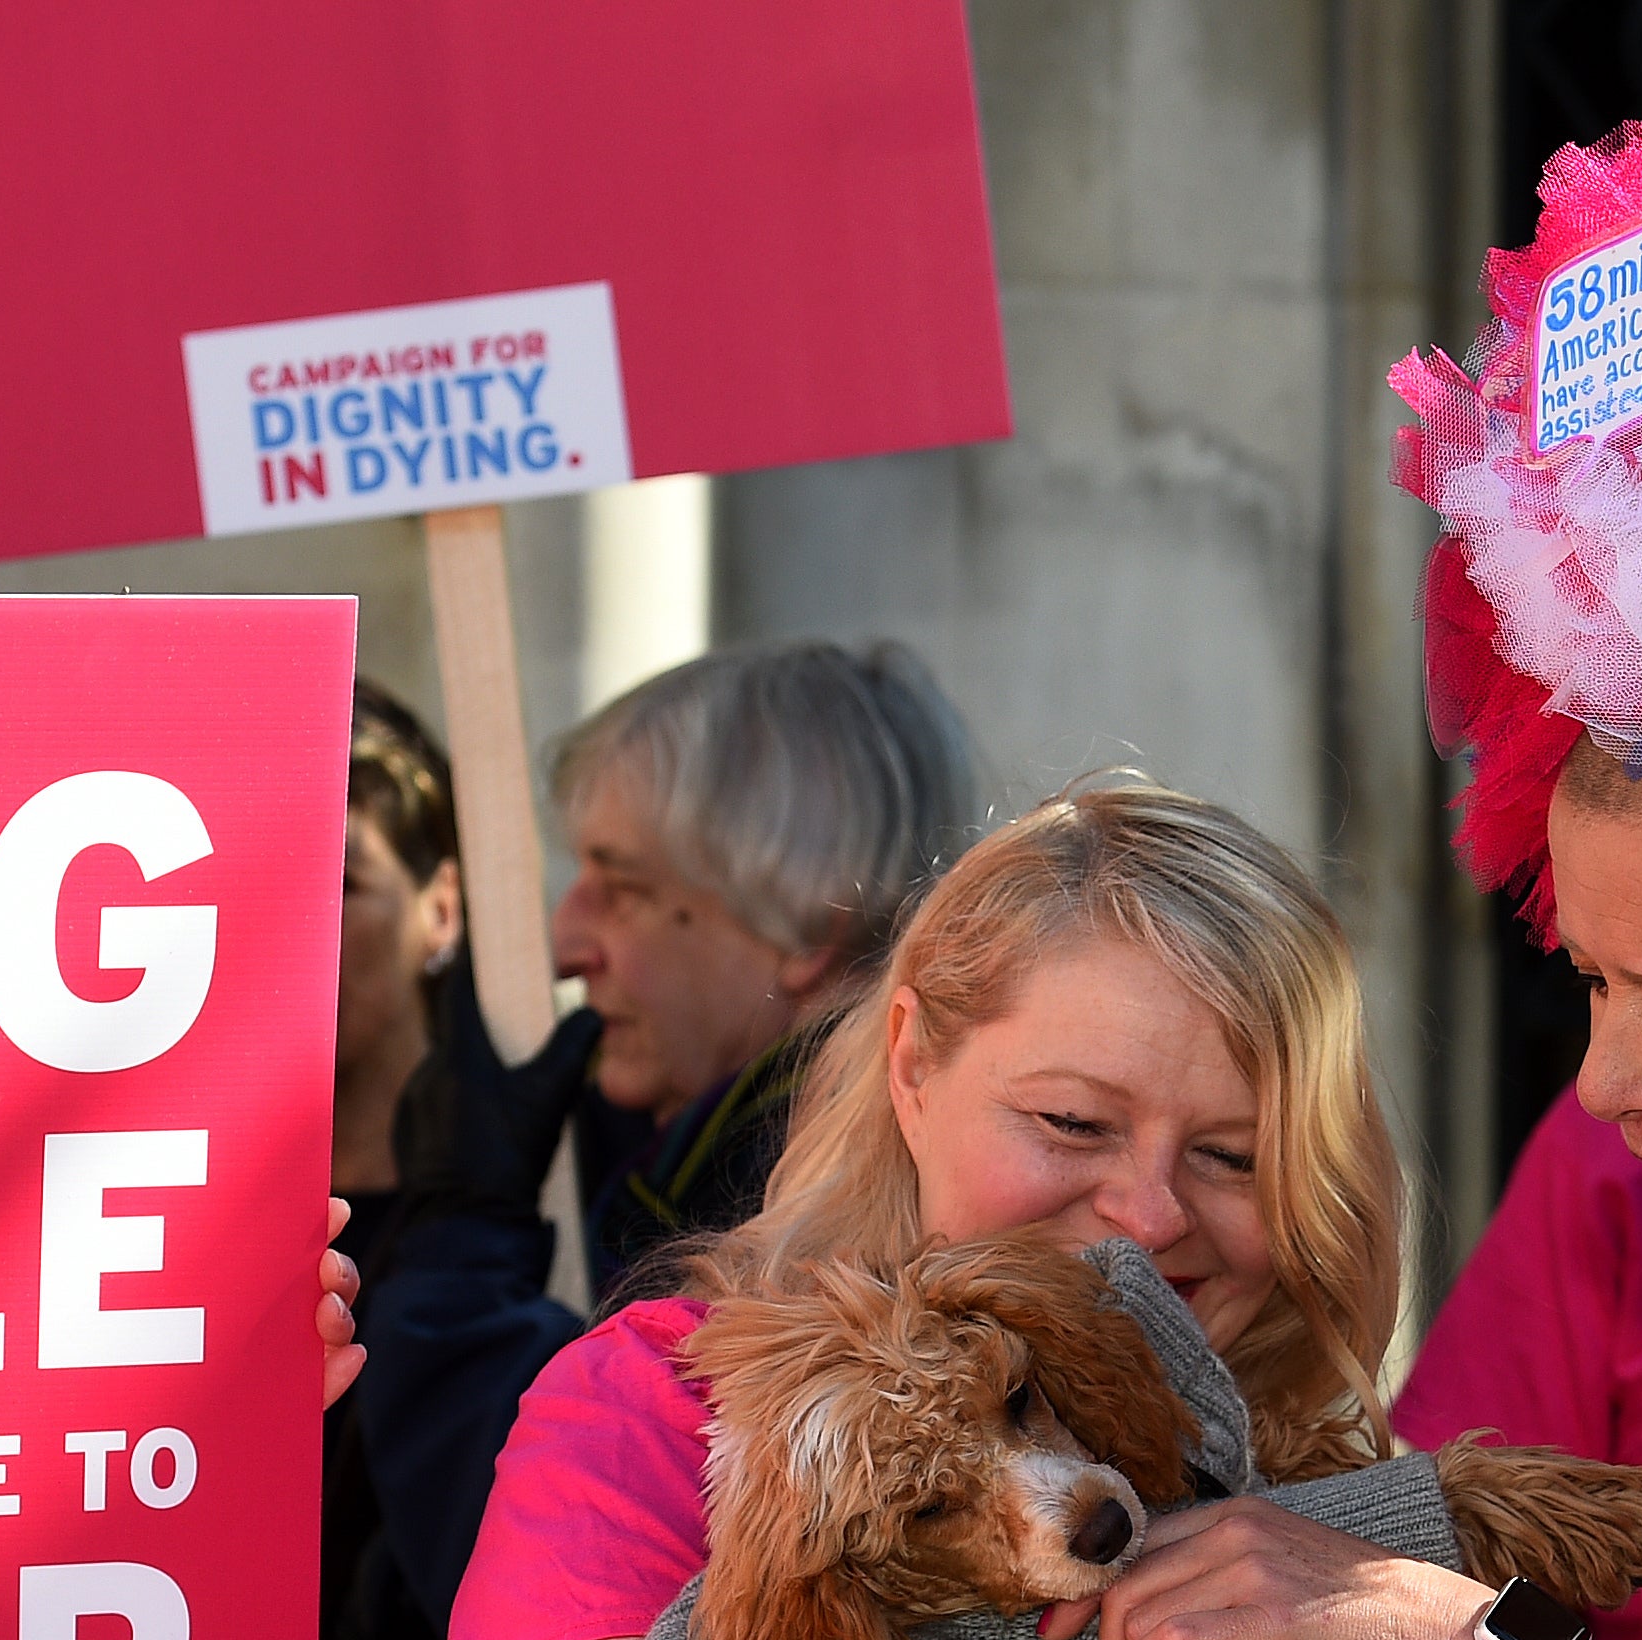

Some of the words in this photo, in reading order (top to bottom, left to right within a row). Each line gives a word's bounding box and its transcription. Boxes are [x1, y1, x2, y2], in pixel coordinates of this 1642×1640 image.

[248, 342, 454, 394] CAMPAIGN
[471, 330, 547, 364] FOR
[1542, 375, 1595, 420] have
[252, 365, 547, 451] DIGNITY
[260, 451, 327, 505] IN
[346, 424, 581, 495] DYING.
[65, 1428, 198, 1511] TO
